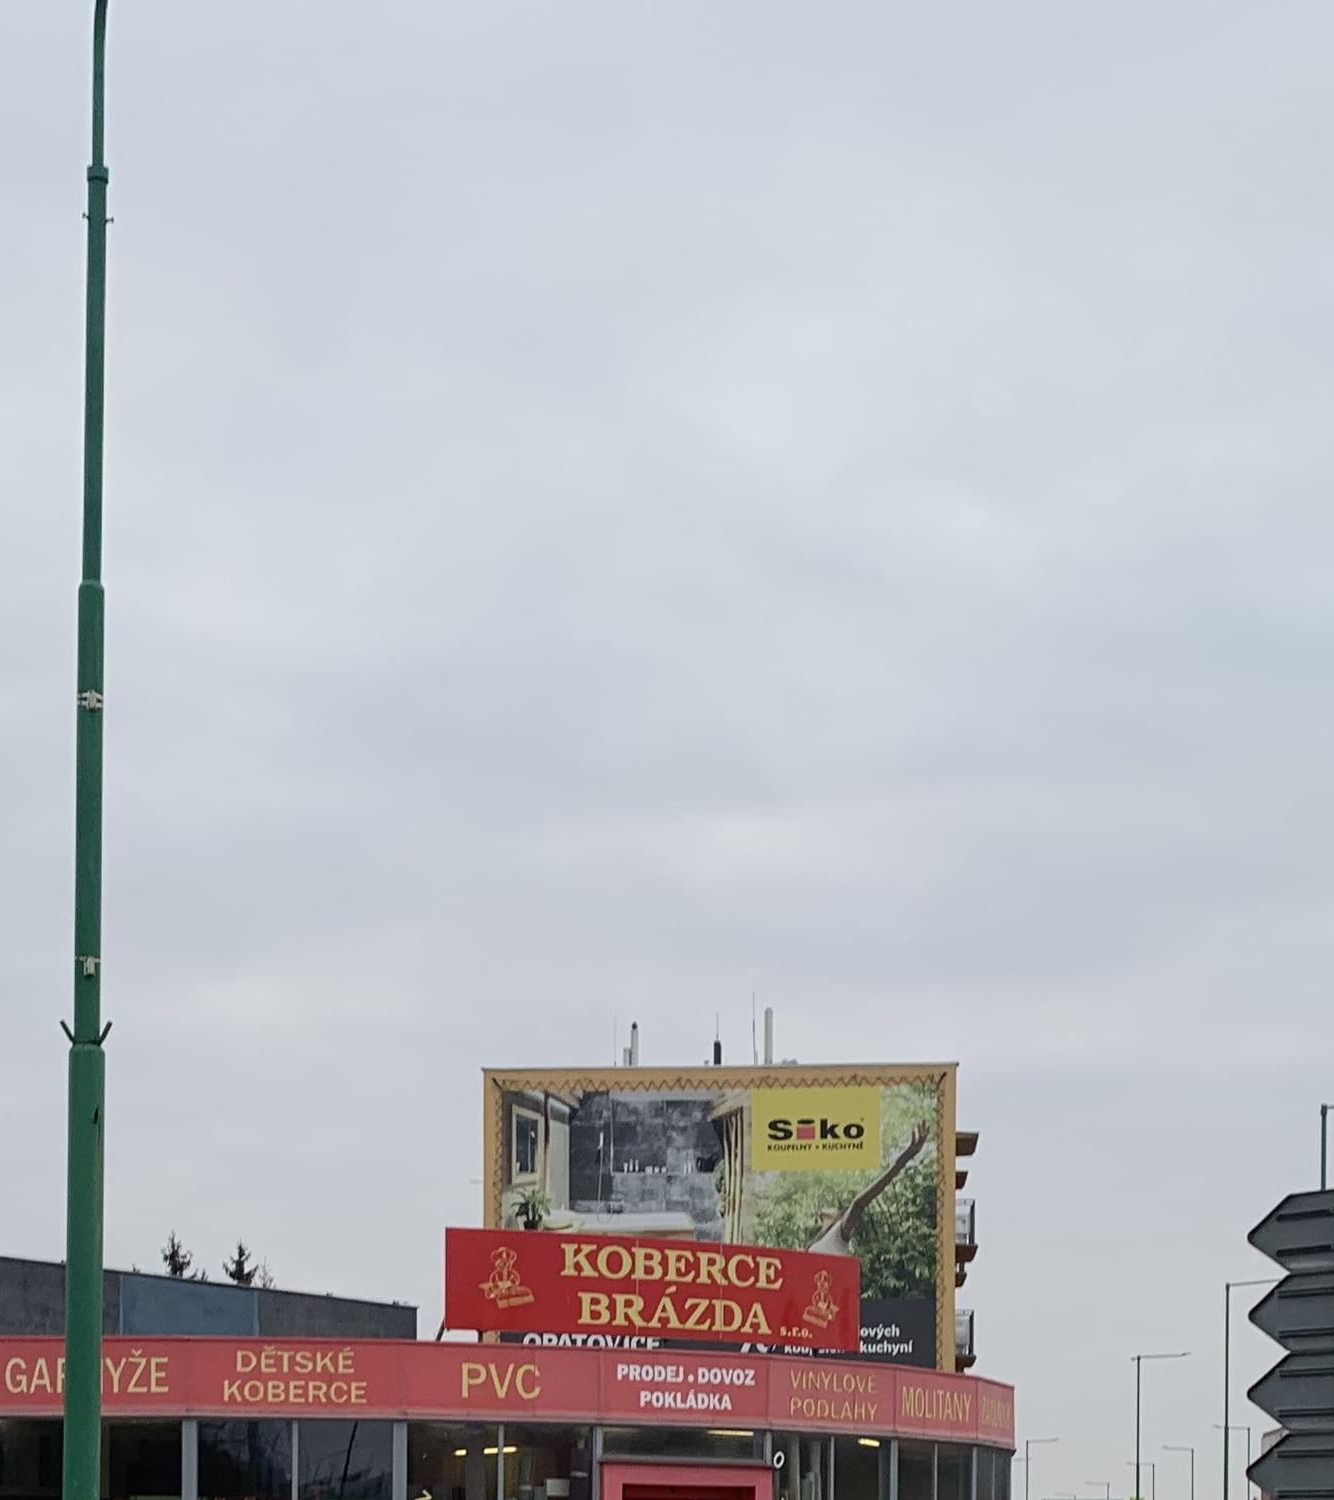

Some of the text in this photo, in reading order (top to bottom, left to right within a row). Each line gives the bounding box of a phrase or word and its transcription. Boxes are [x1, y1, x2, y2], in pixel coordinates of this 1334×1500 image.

[560, 1242, 783, 1289] KOBERCE
[578, 1286, 813, 1339] BRÁZDA s.r.o.
[860, 1323, 900, 1340] ových
[235, 1346, 355, 1374] DĚTSKÉ
[860, 1340, 913, 1356] kuchyní
[4, 1348, 169, 1395] GAYŽE
[460, 1362, 541, 1400] PVC
[617, 1363, 755, 1386] PRODEJ DOVOZ
[223, 1379, 367, 1404] KOBERCE
[639, 1389, 732, 1410] POKLÁDKA
[901, 1385, 971, 1422] MOLITANY
[790, 1396, 878, 1421] PODLAHY
